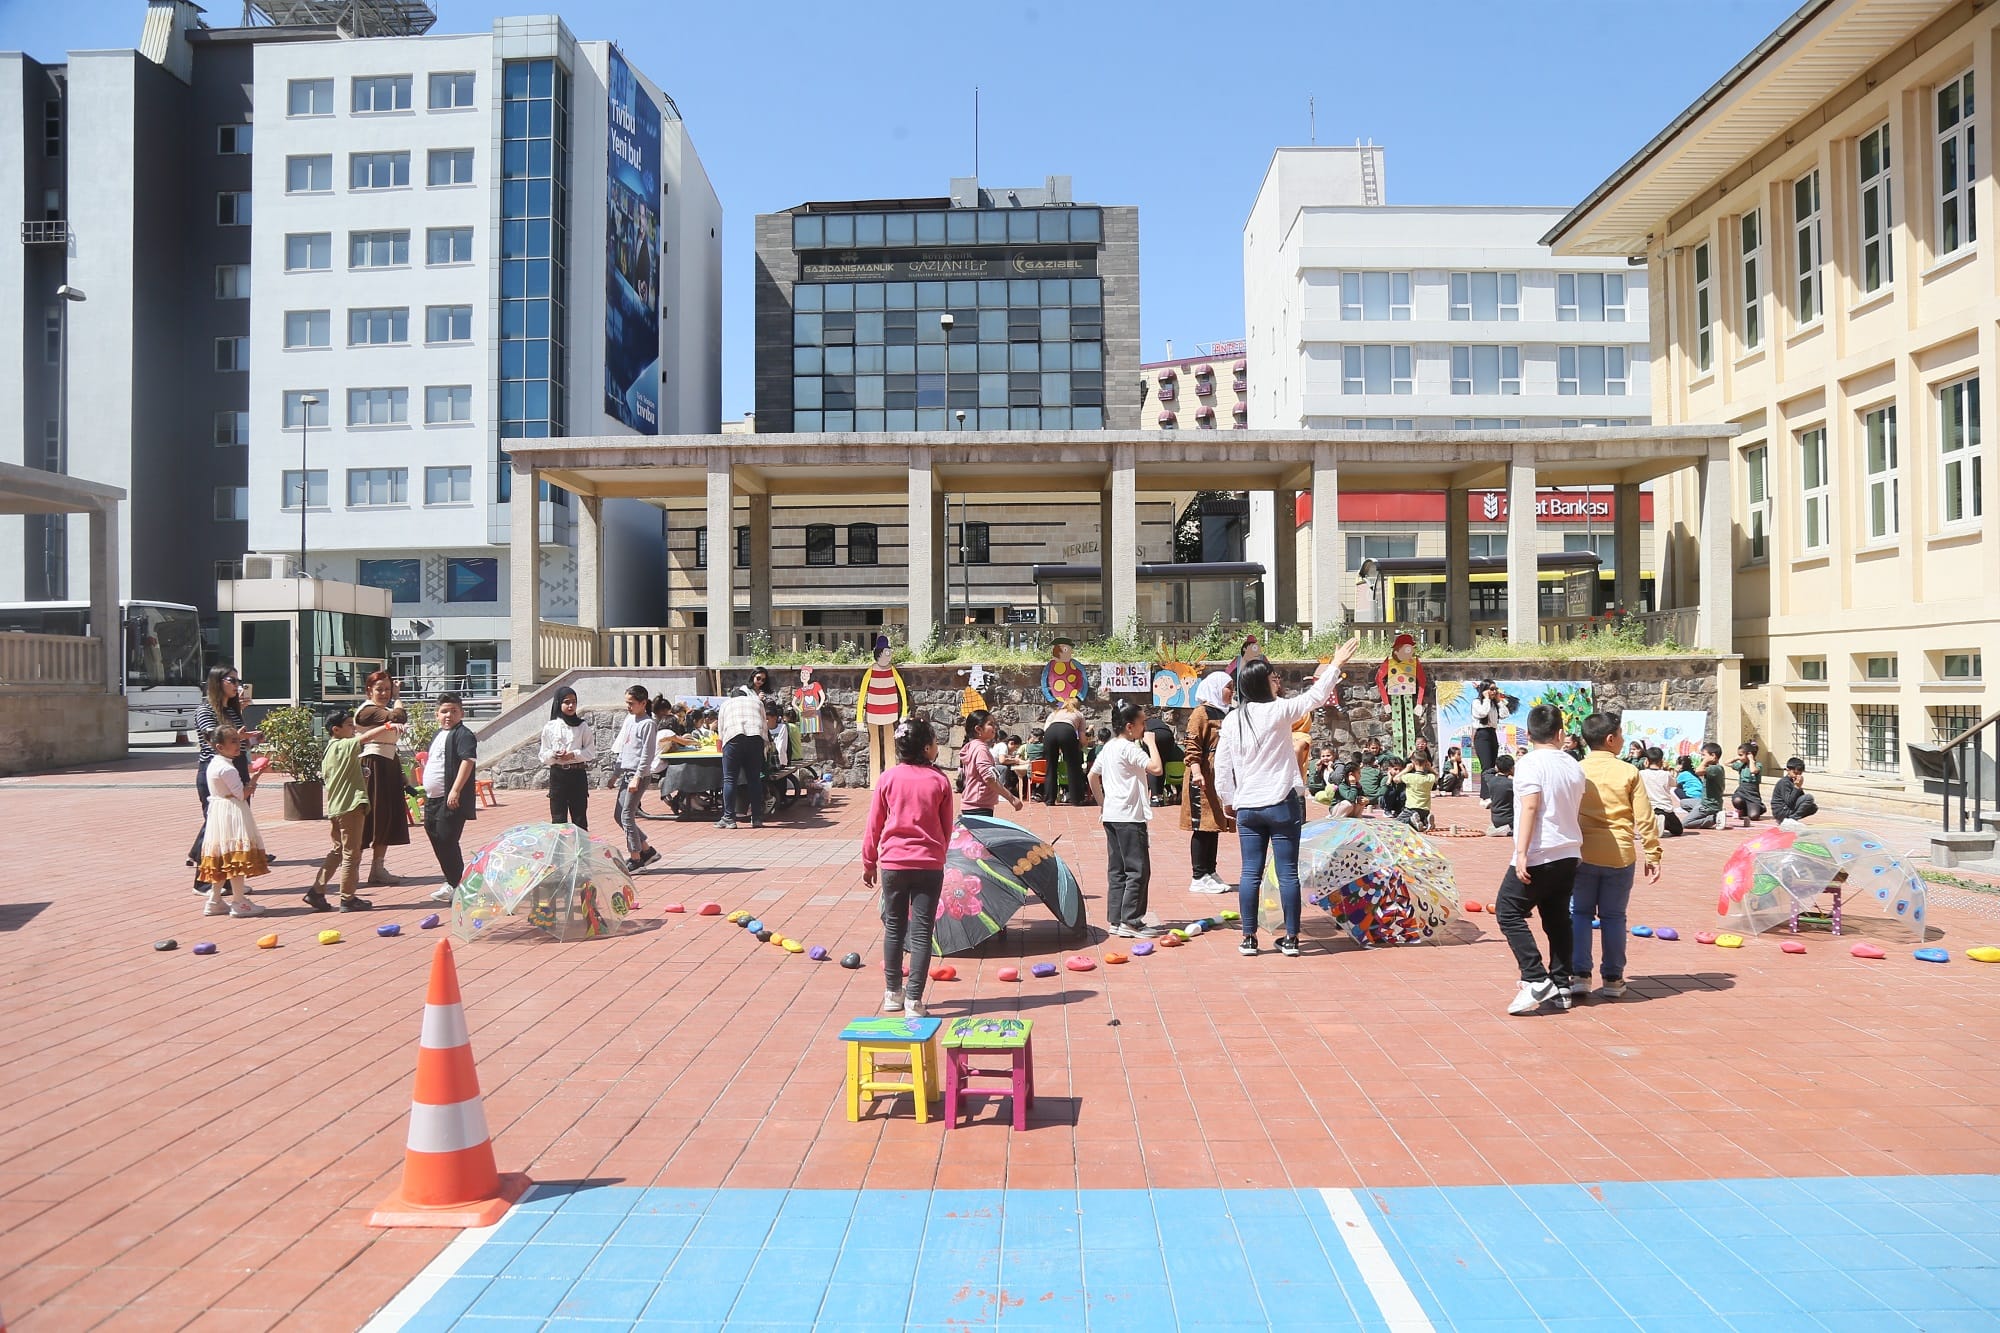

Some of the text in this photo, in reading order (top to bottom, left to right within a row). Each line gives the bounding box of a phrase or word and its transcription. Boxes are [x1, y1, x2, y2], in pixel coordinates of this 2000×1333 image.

[612, 98, 635, 136] Tivibu
[611, 127, 641, 172] Yeni bu!
[1550, 498, 1609, 516] Bankası
